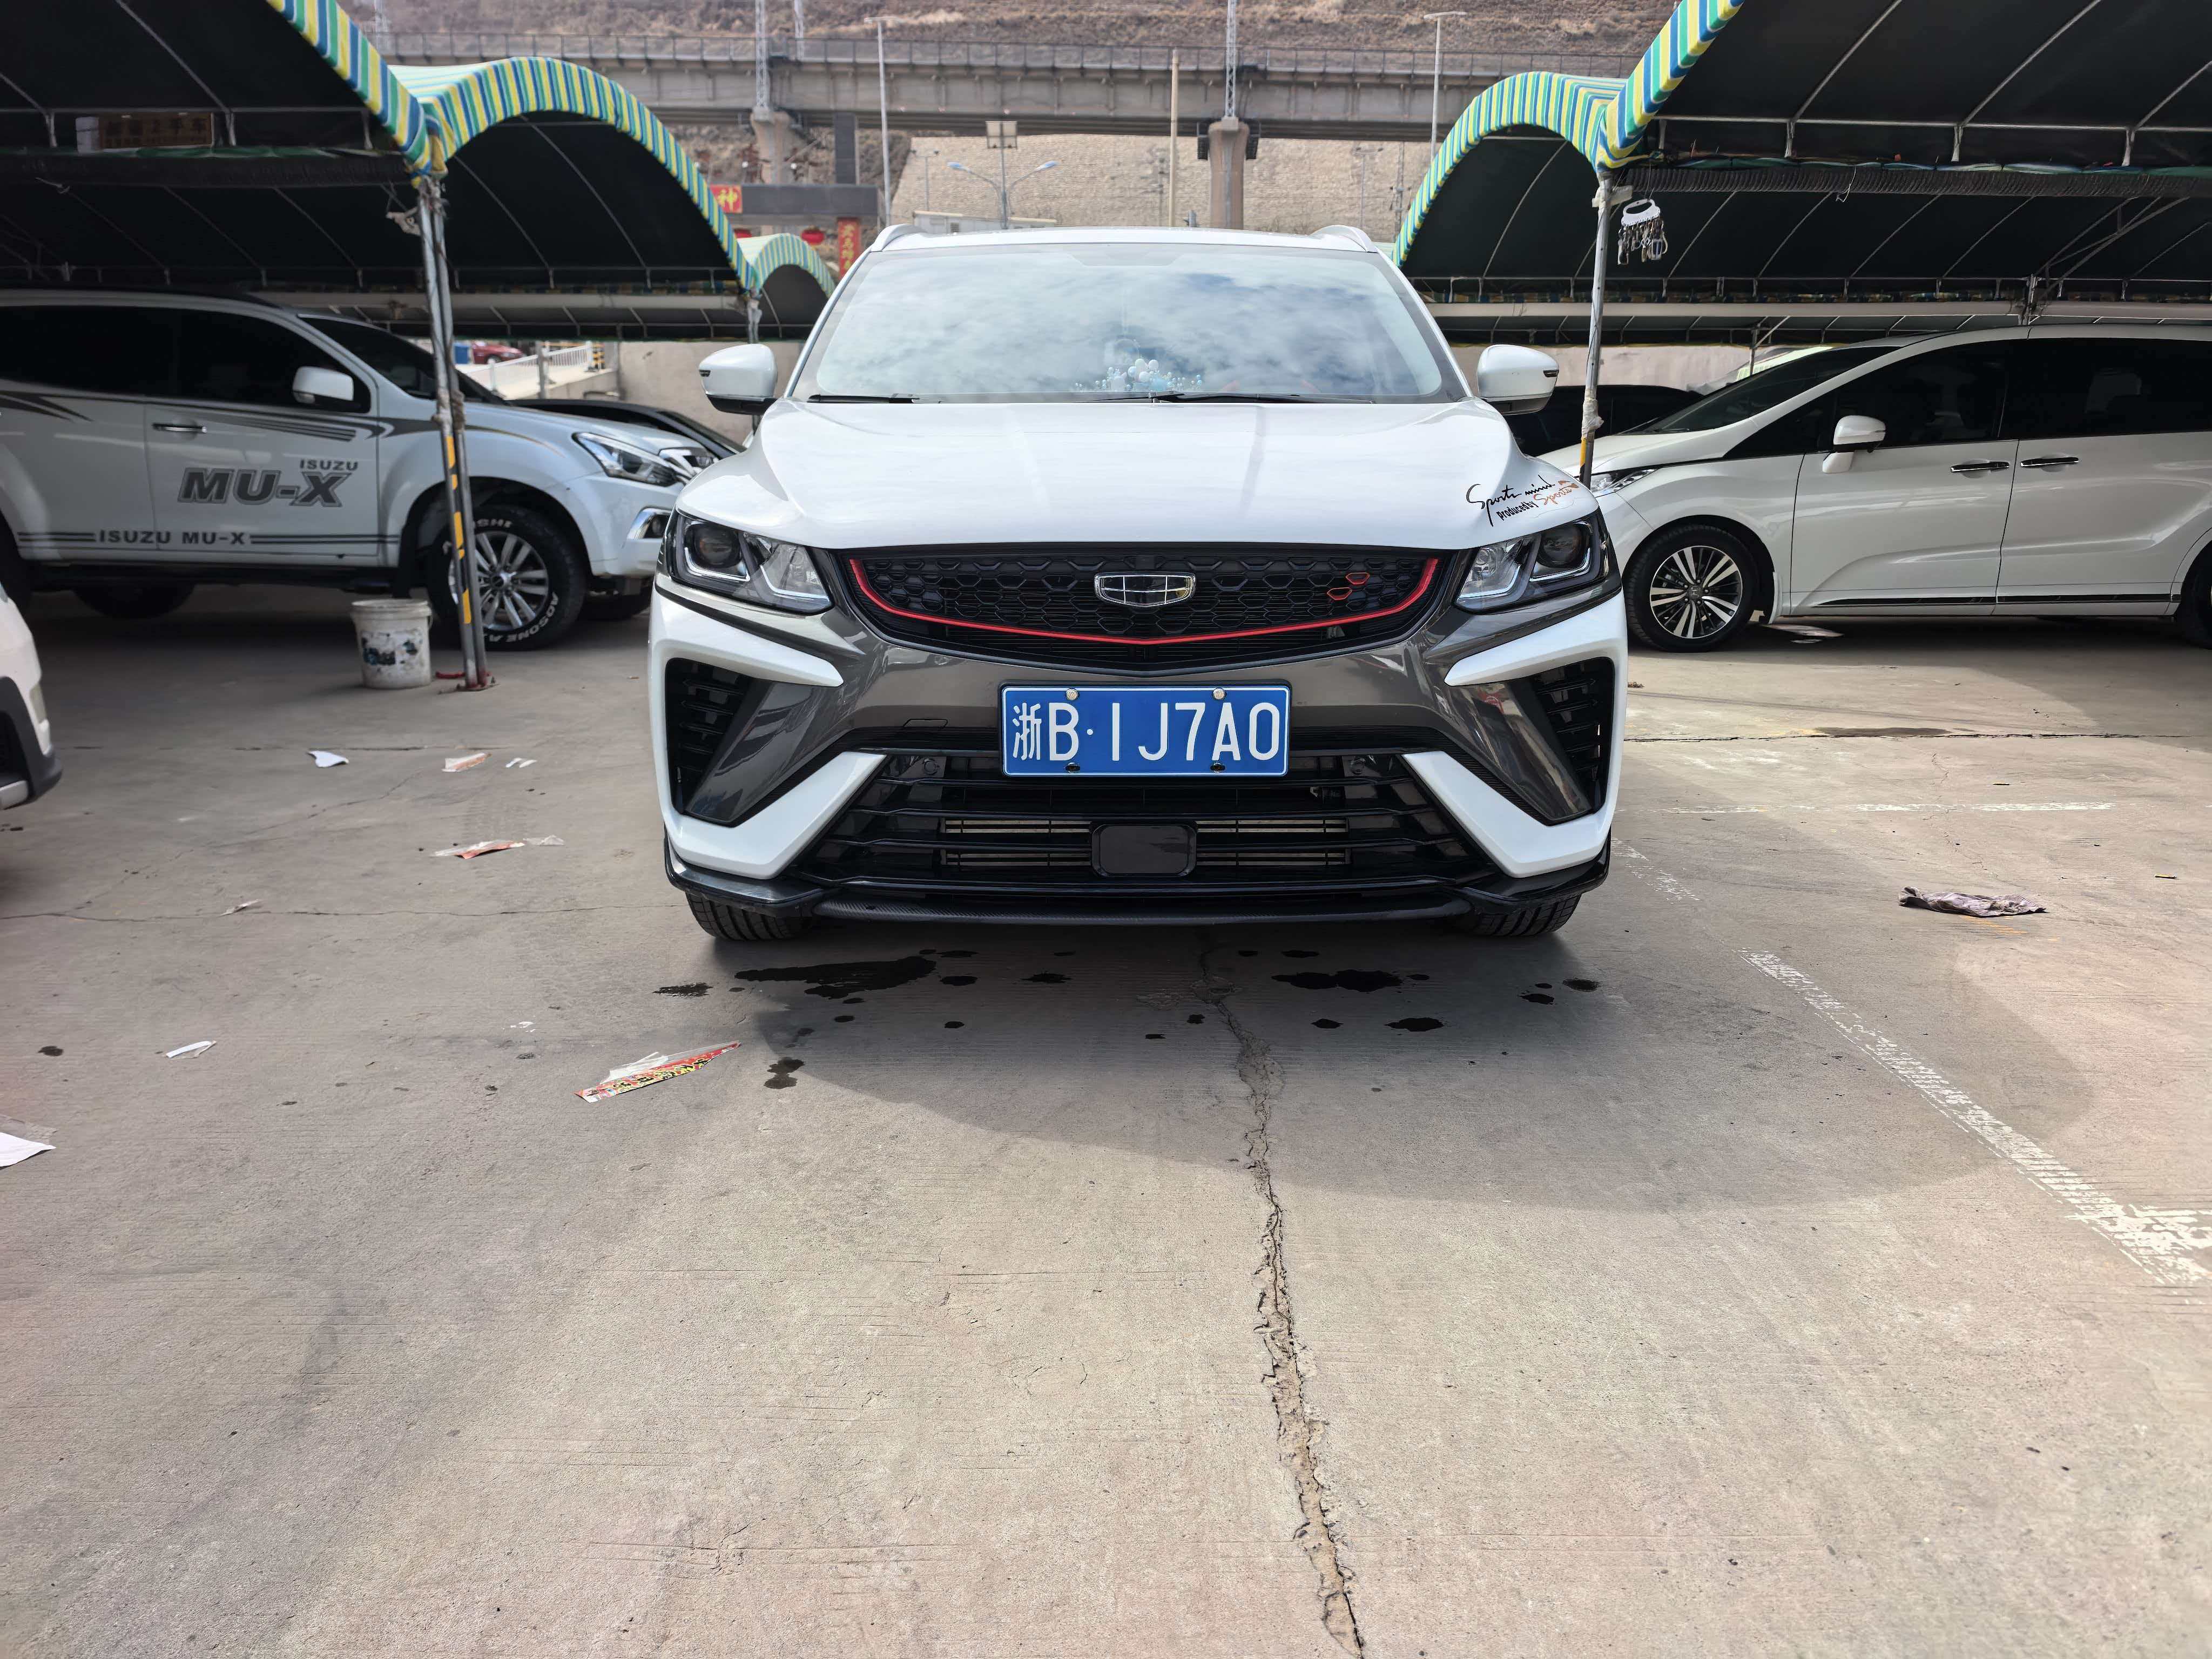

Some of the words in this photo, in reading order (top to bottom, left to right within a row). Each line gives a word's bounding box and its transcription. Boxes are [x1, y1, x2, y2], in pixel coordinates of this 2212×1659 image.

[299, 459, 359, 471] ISUZU
[177, 467, 353, 508] MU-X
[99, 530, 171, 544] ISUZU
[182, 531, 245, 545] MU-X
